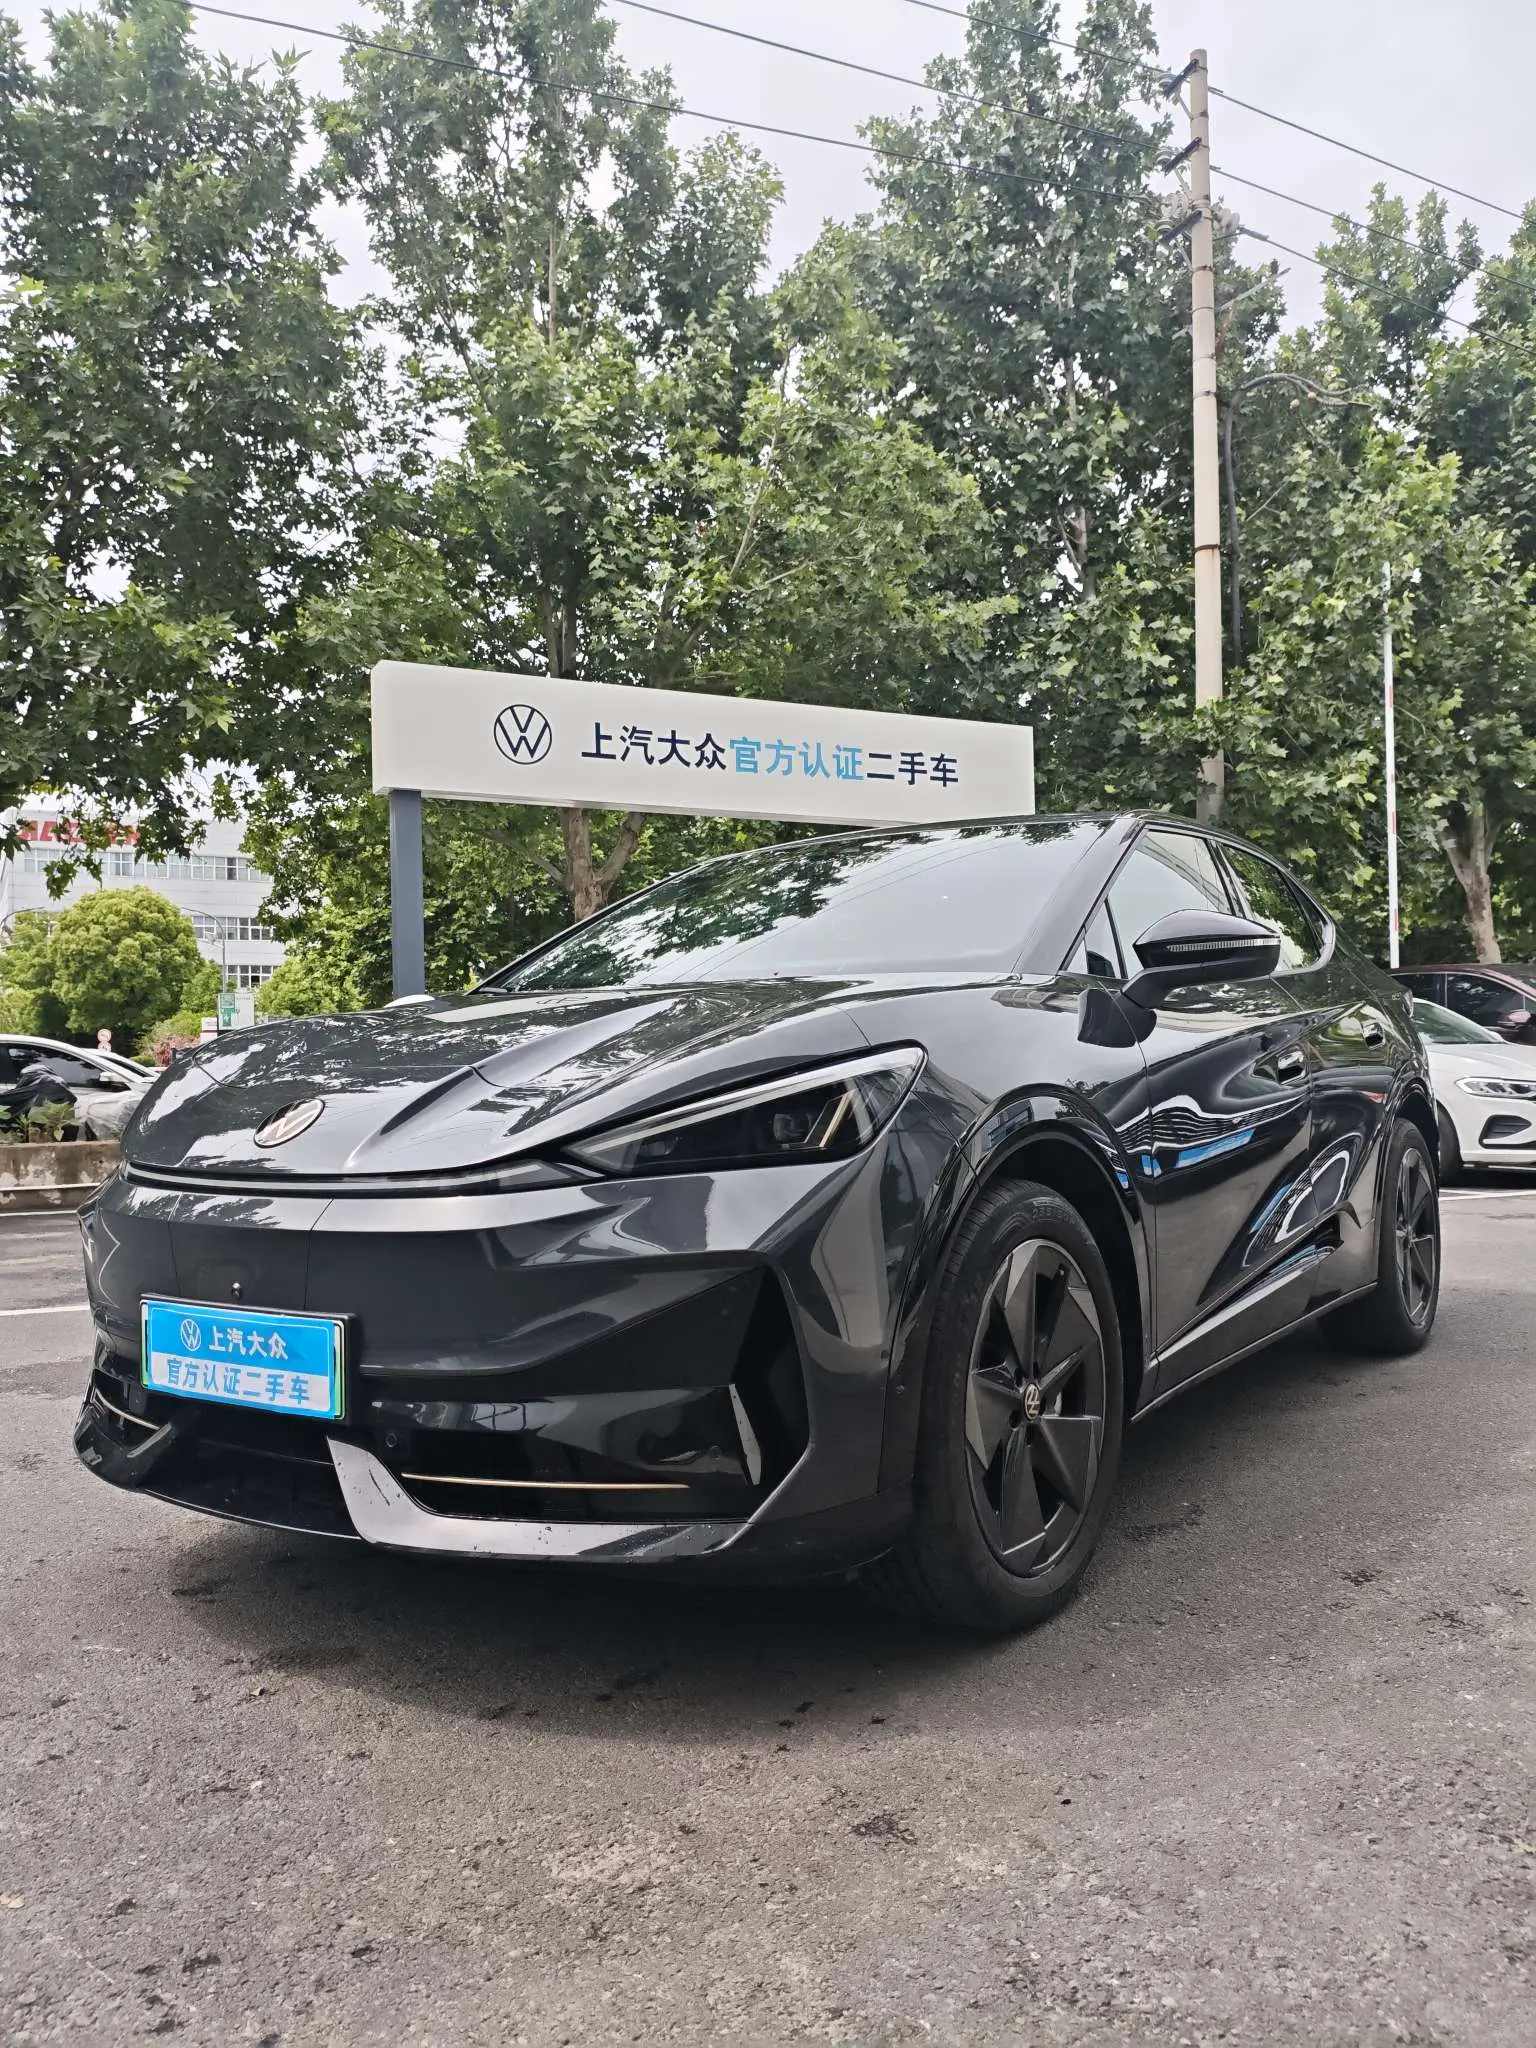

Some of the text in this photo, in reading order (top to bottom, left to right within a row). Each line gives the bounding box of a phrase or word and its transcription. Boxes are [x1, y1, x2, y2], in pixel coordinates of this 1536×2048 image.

[493, 704, 552, 765] VW
[582, 722, 959, 787] 上汽大众官方认证二手车
[180, 1319, 201, 1351] VW
[208, 1326, 288, 1360] 上汽大众
[167, 1357, 310, 1405] 官方认证二手车
